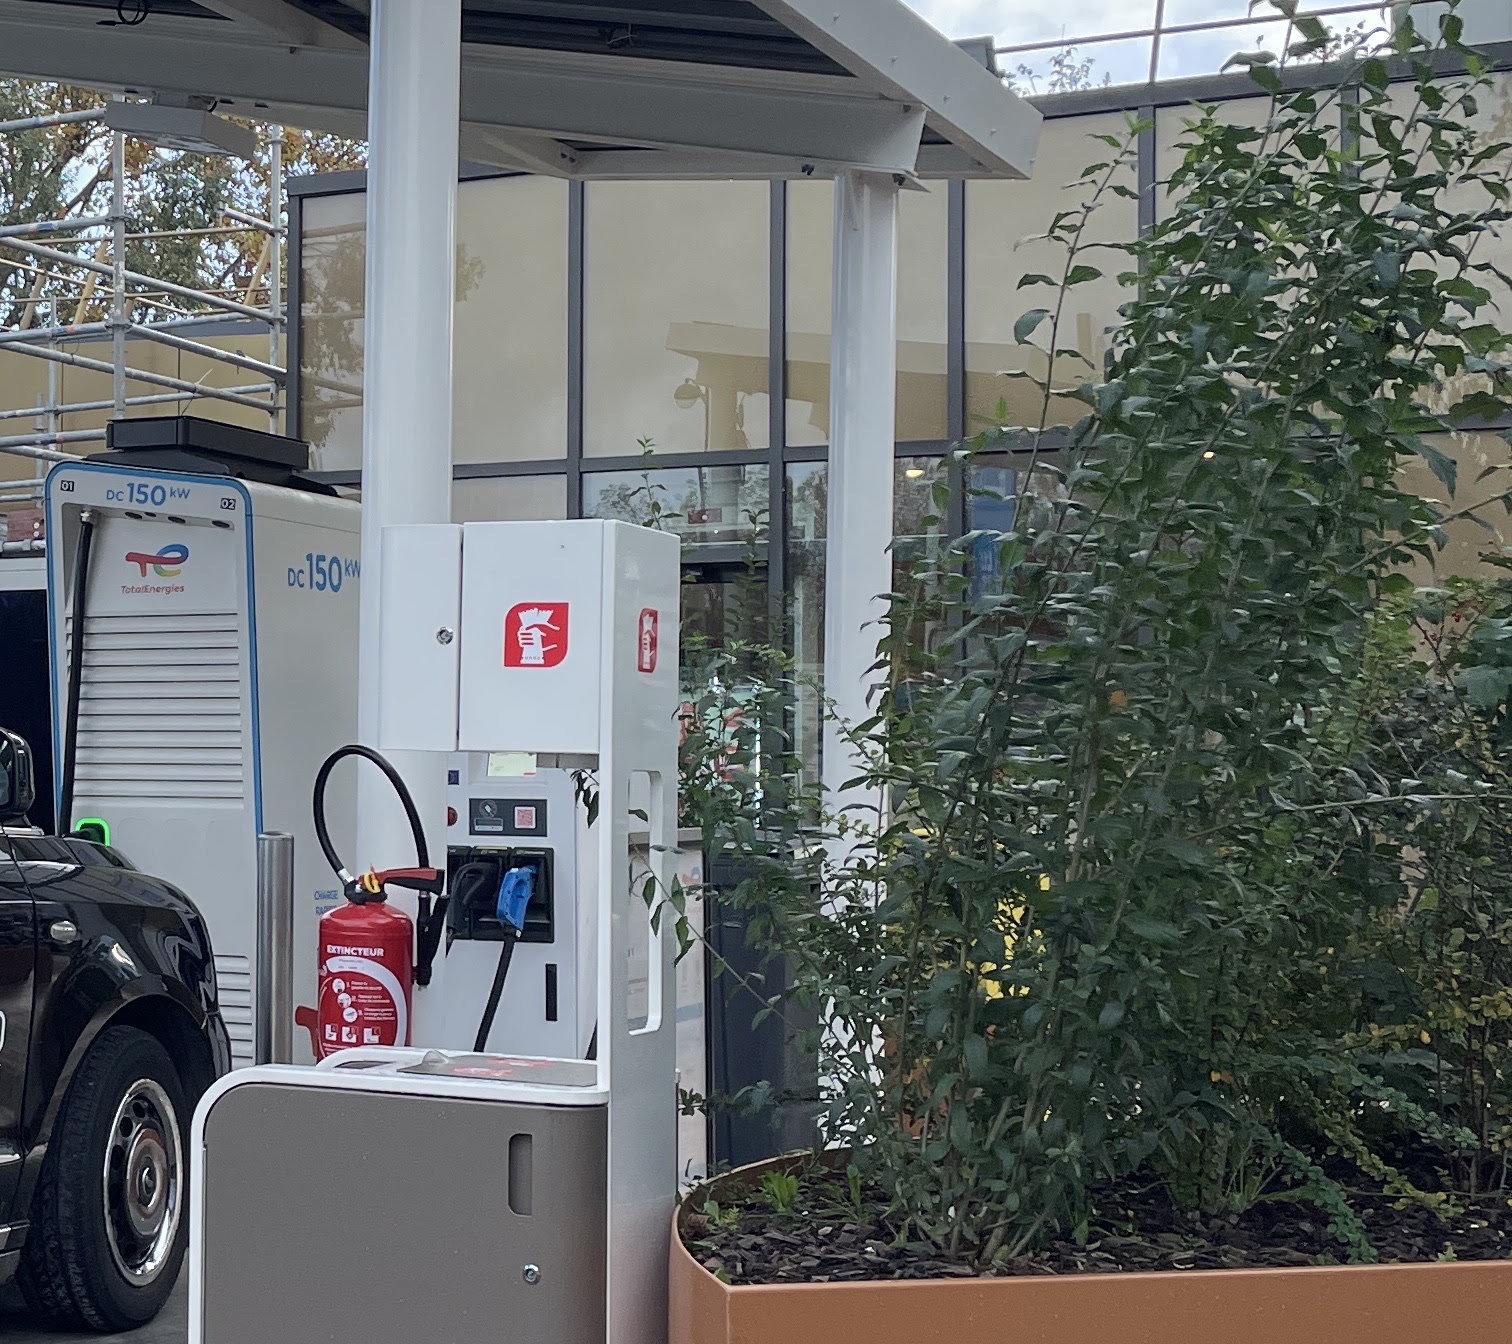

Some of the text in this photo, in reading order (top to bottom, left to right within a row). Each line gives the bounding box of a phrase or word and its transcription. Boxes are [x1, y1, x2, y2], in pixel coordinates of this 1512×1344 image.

[61, 481, 74, 491] 01
[106, 482, 191, 506] DC 150 kW
[221, 499, 236, 510] 02
[287, 552, 361, 593] DC 150 kW
[121, 584, 185, 595] TotalEnergies
[326, 944, 385, 956] EXTINCTEUR
